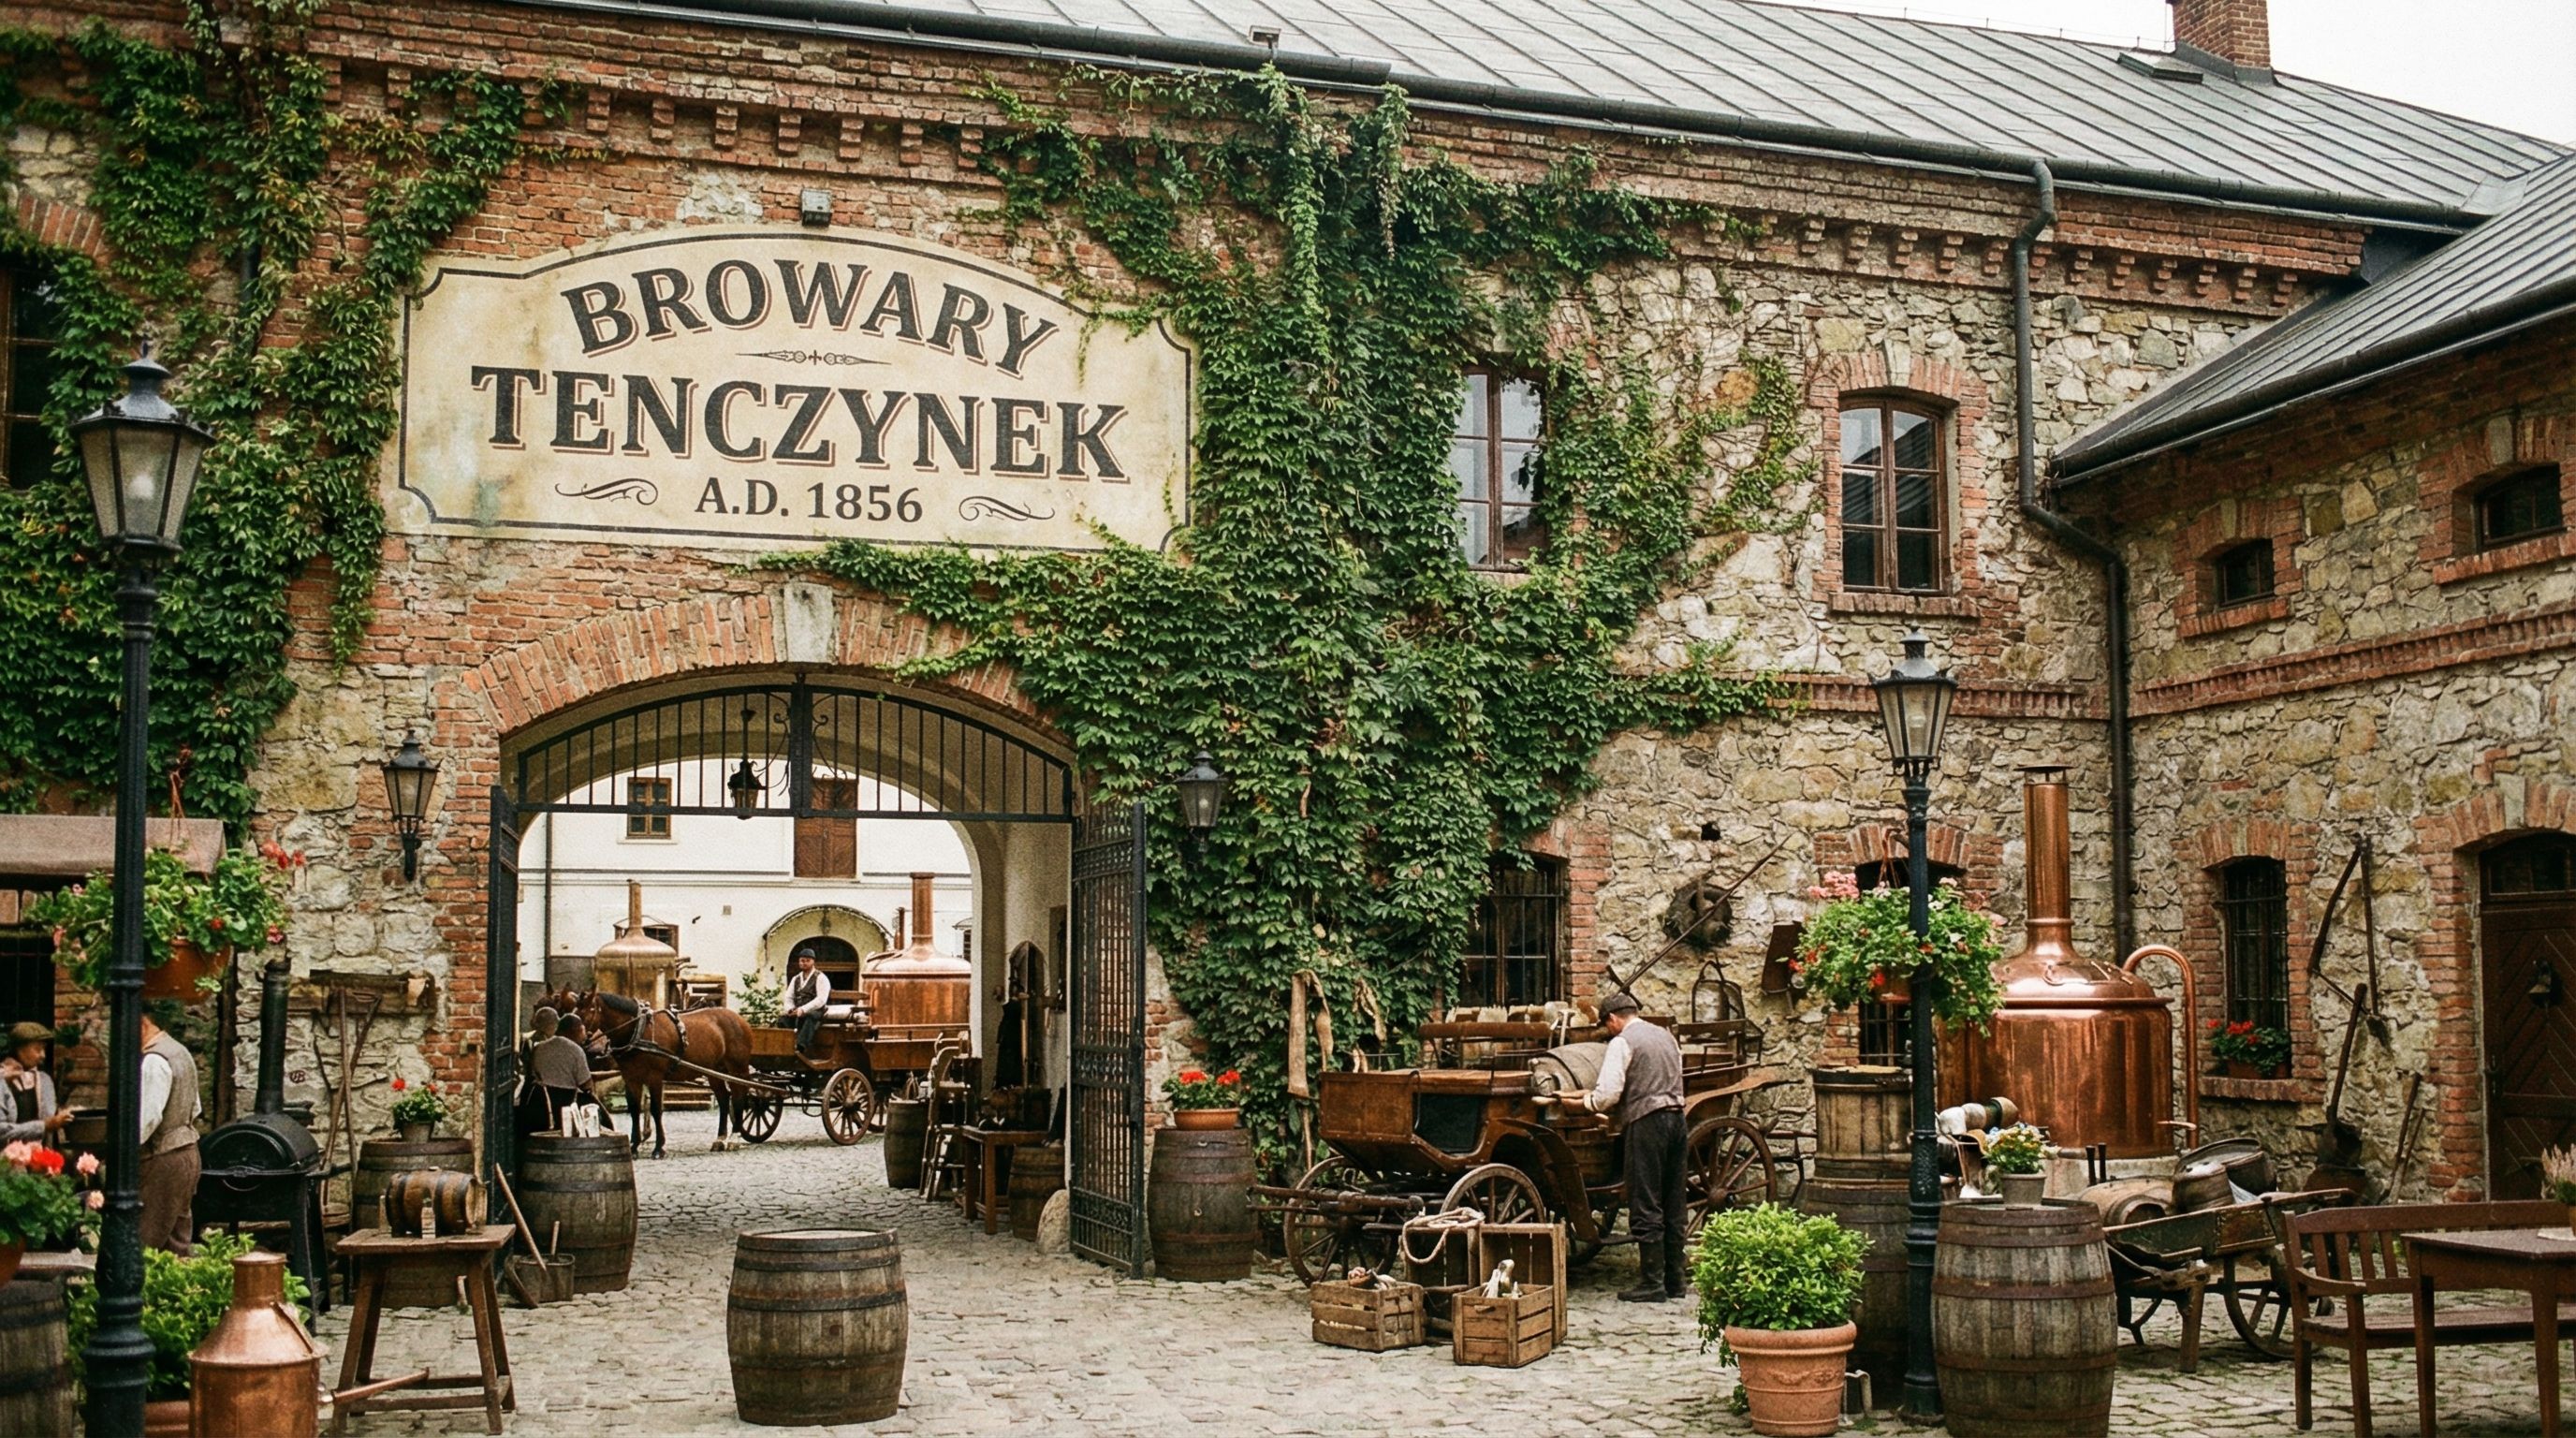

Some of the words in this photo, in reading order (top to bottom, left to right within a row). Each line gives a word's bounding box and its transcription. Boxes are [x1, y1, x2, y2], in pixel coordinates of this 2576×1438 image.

[562, 257, 1058, 378] BROWARY
[472, 366, 1130, 483] TENCZYNEK
[695, 477, 789, 518] A.D.
[808, 483, 924, 523] 1856
